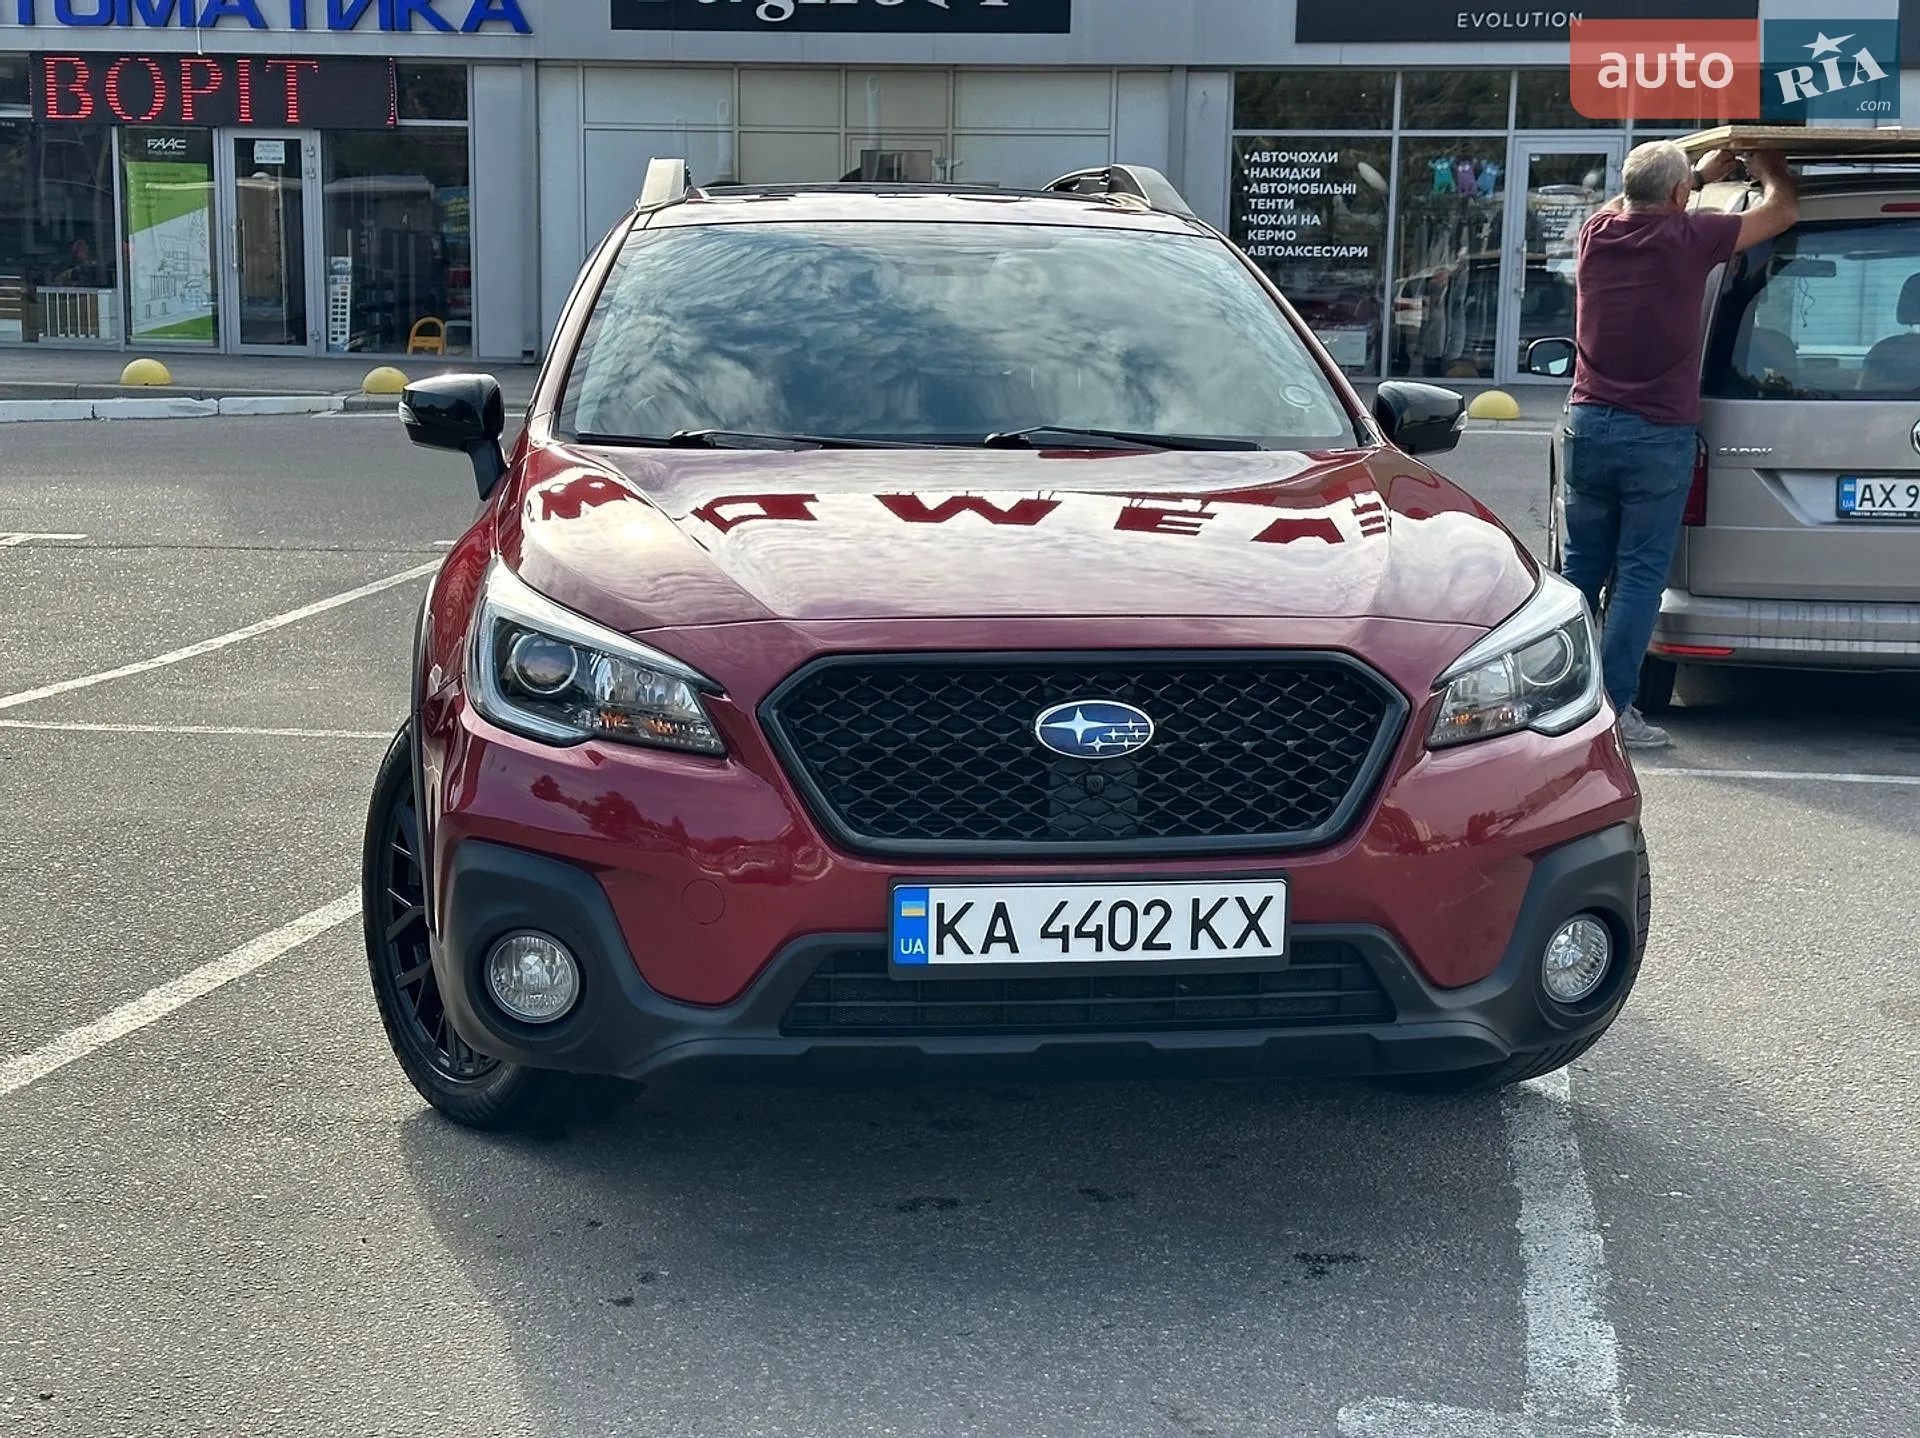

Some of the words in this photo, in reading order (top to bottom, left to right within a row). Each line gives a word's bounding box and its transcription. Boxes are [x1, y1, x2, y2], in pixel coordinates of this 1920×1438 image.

[1457, 12, 1583, 28] EVOLUTION
[43, 56, 319, 125] ВОРІТ
[146, 138, 187, 150] FAAC
[1250, 151, 1339, 163] АВТОЧОХЛИ
[1250, 167, 1321, 181] НАКИДКИ
[1249, 182, 1357, 194] АВТОМОБІЛЬНІ
[1248, 198, 1295, 210] ТЕНТИ
[1248, 213, 1297, 226] ЧОХЛИ
[1301, 214, 1321, 226] НА
[1247, 229, 1297, 241] КЕРМО
[1246, 245, 1369, 258] АВТОАКСЕСУАРИ
[1857, 483, 1897, 509] AX
[1841, 499, 1856, 508] UA
[934, 900, 1021, 956] KA
[1039, 898, 1174, 954] 4402
[1189, 895, 1274, 951] KX
[900, 937, 926, 956] UA
